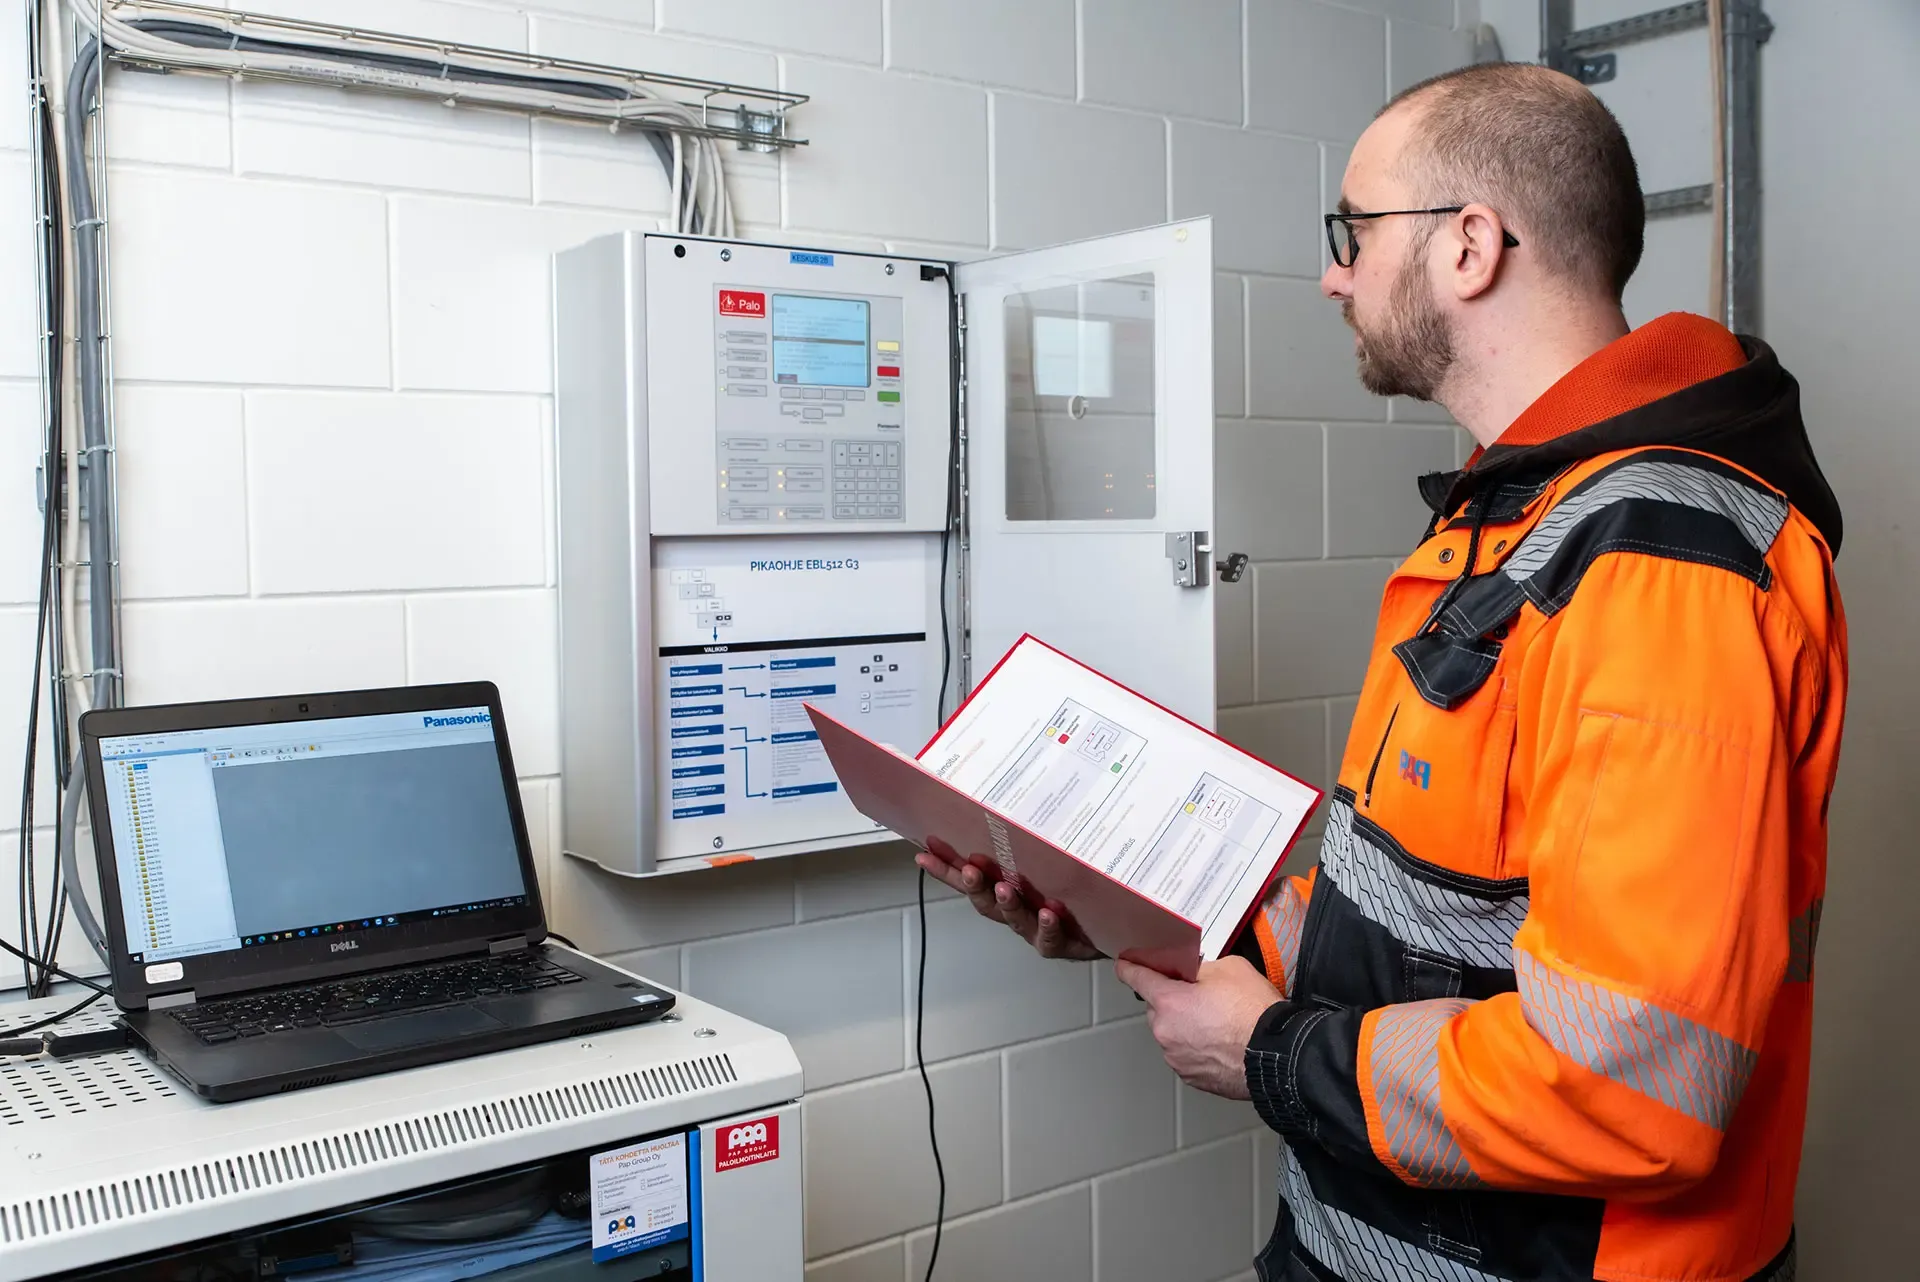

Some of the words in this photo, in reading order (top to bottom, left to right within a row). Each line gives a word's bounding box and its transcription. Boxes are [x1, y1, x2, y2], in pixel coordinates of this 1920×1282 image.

[792, 254, 819, 264] KESKUS
[739, 300, 760, 310] Palo
[750, 560, 803, 571] PIKAOHJE
[806, 560, 843, 570] EBL512
[846, 558, 859, 570] G3
[424, 712, 492, 727] Panasonic
[331, 941, 359, 952] DELL
[599, 1156, 614, 1165] TÄTÄ
[616, 1149, 649, 1161] KOHDETTA
[651, 1140, 680, 1152] HUOLTAA
[744, 1145, 766, 1153] GROUP
[618, 1161, 630, 1169] Pap
[632, 1156, 651, 1165] Group
[719, 1150, 776, 1168] PALOILMOITINLAITE
